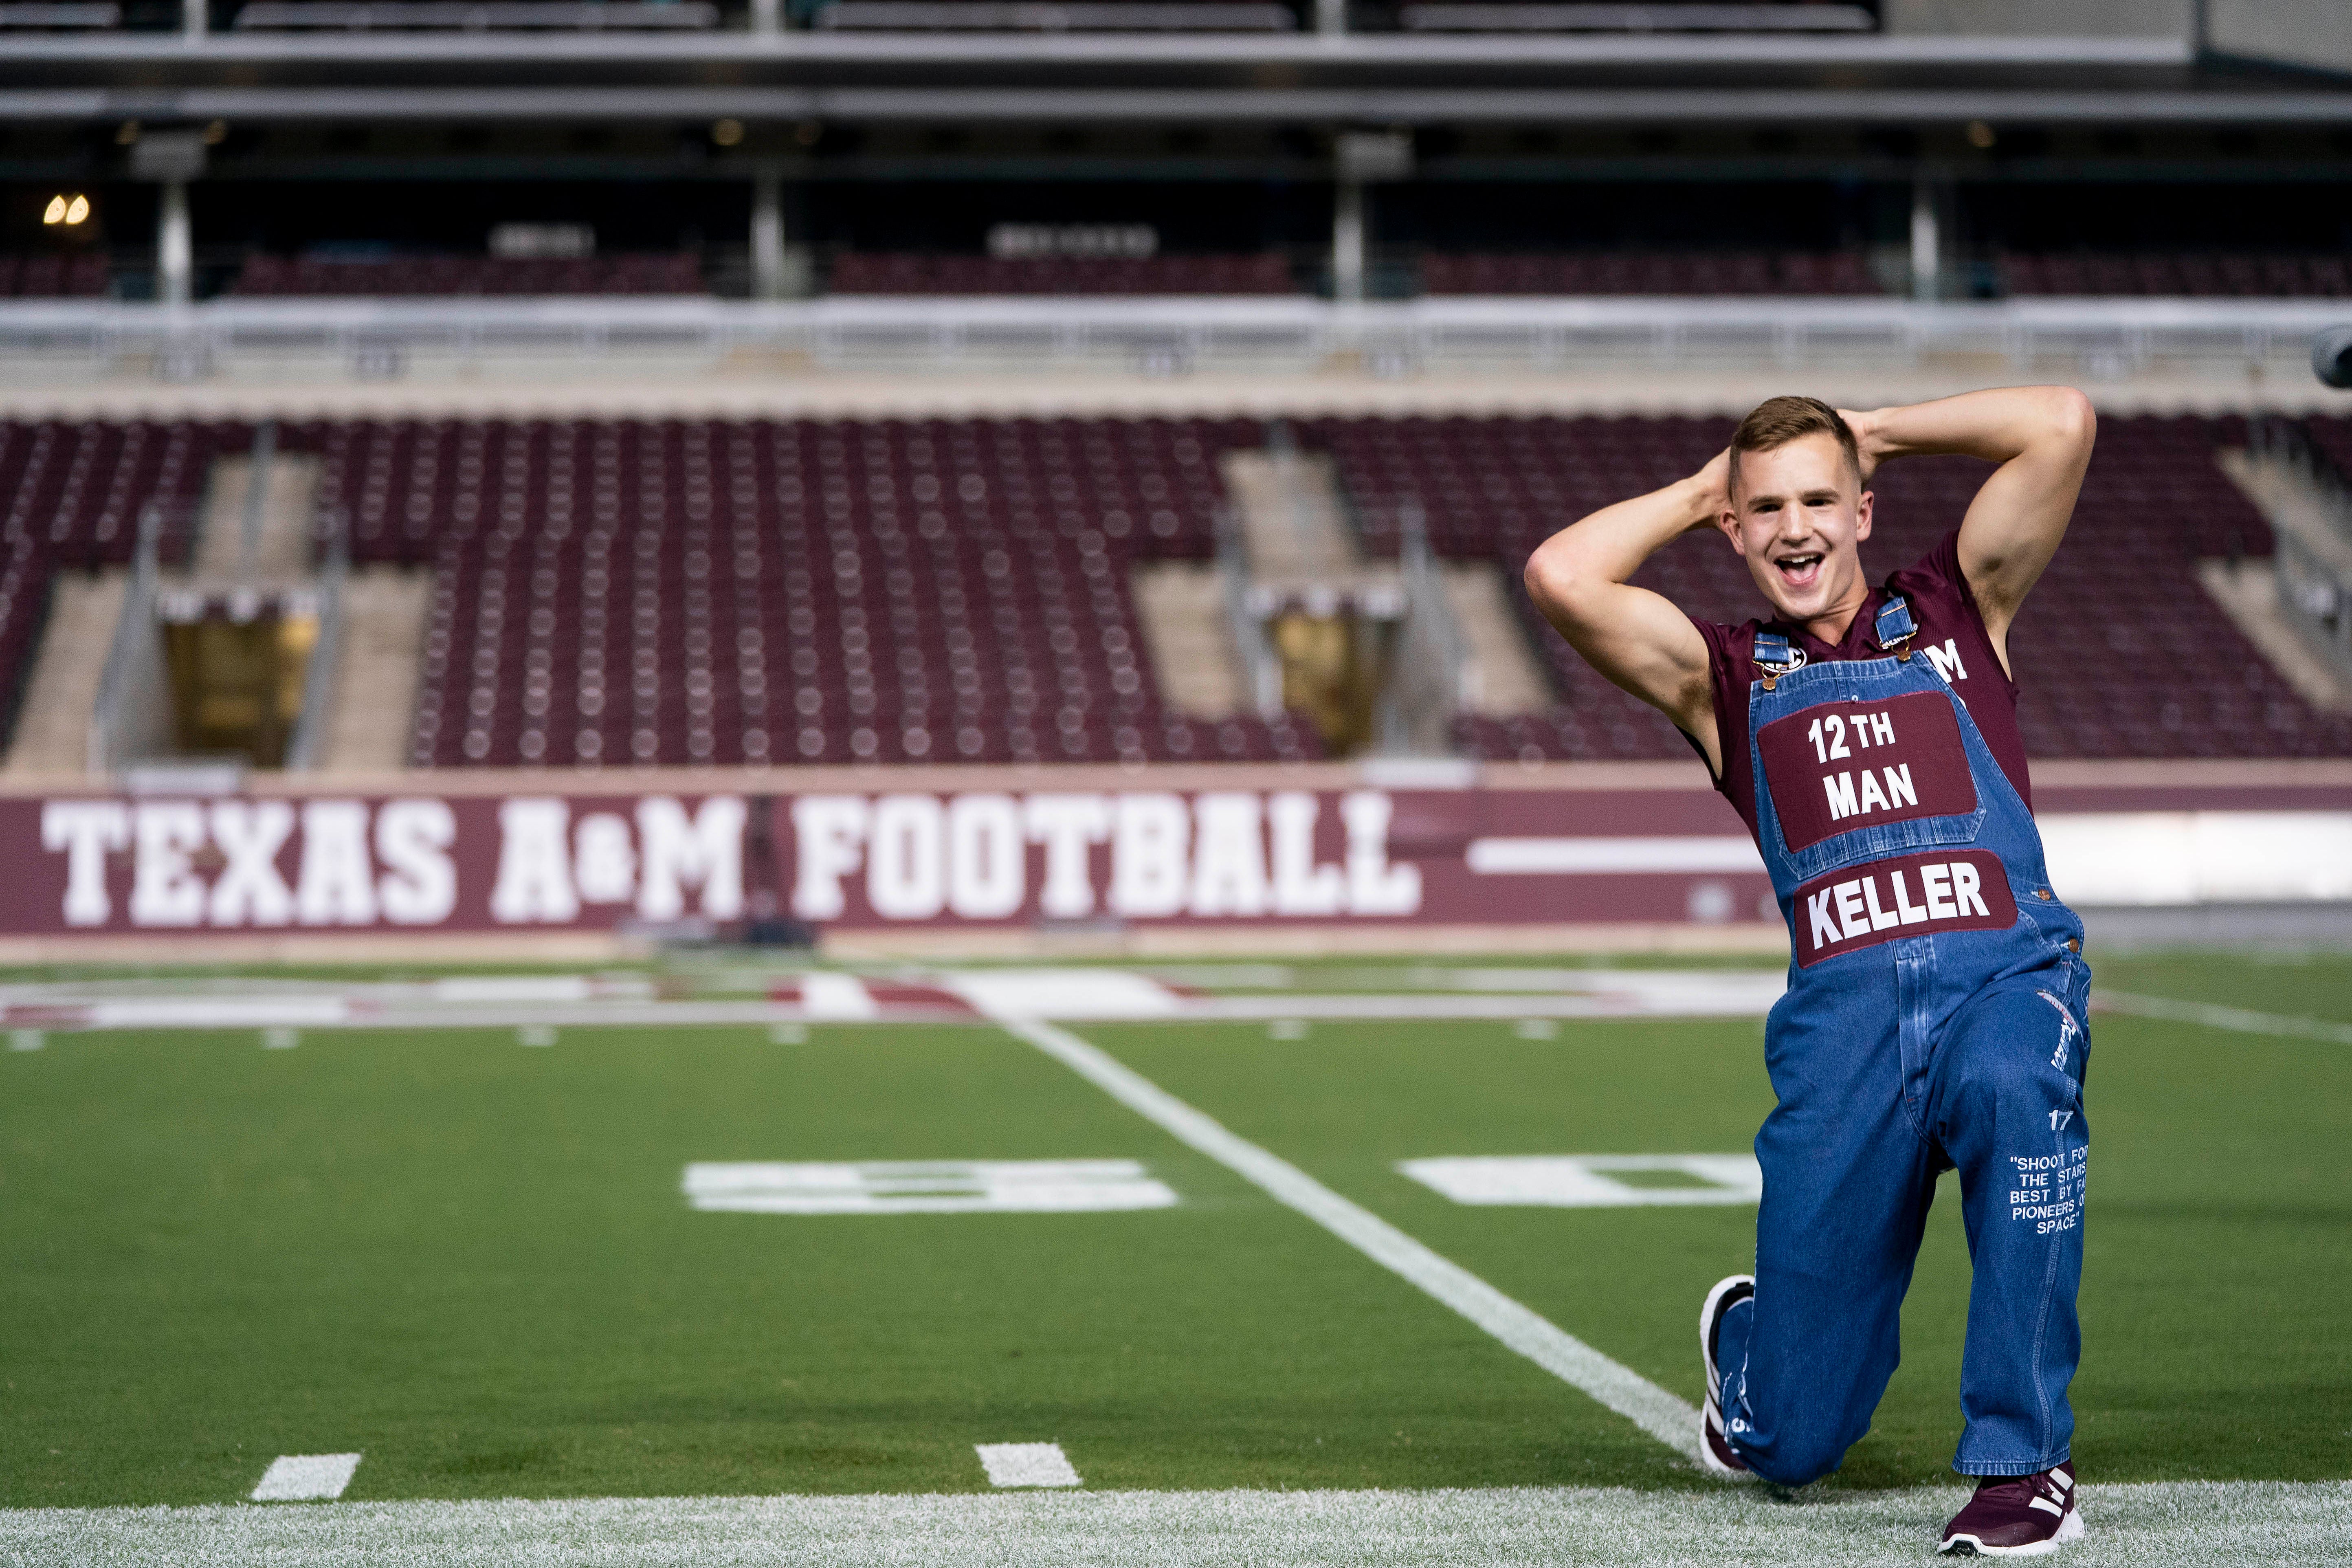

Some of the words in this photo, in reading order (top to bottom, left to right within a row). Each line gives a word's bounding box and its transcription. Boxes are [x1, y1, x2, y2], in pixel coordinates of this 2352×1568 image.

[1822, 763, 1918, 821] MAN
[42, 797, 458, 928] TEXAS
[488, 793, 750, 924] A&M
[791, 789, 1423, 921] FOOTBALL
[1807, 862, 1990, 950] KELLER
[2049, 1109, 2074, 1131] 17
[2010, 1154, 2065, 1170] "SHOOT
[2072, 1145, 2088, 1162] FOR
[2010, 1189, 2051, 1204] BEST
[2060, 1183, 2072, 1200] BY
[2077, 1174, 2086, 1193] FA
[2019, 1173, 2049, 1187] THE
[2012, 1199, 2075, 1221] PIONEERS
